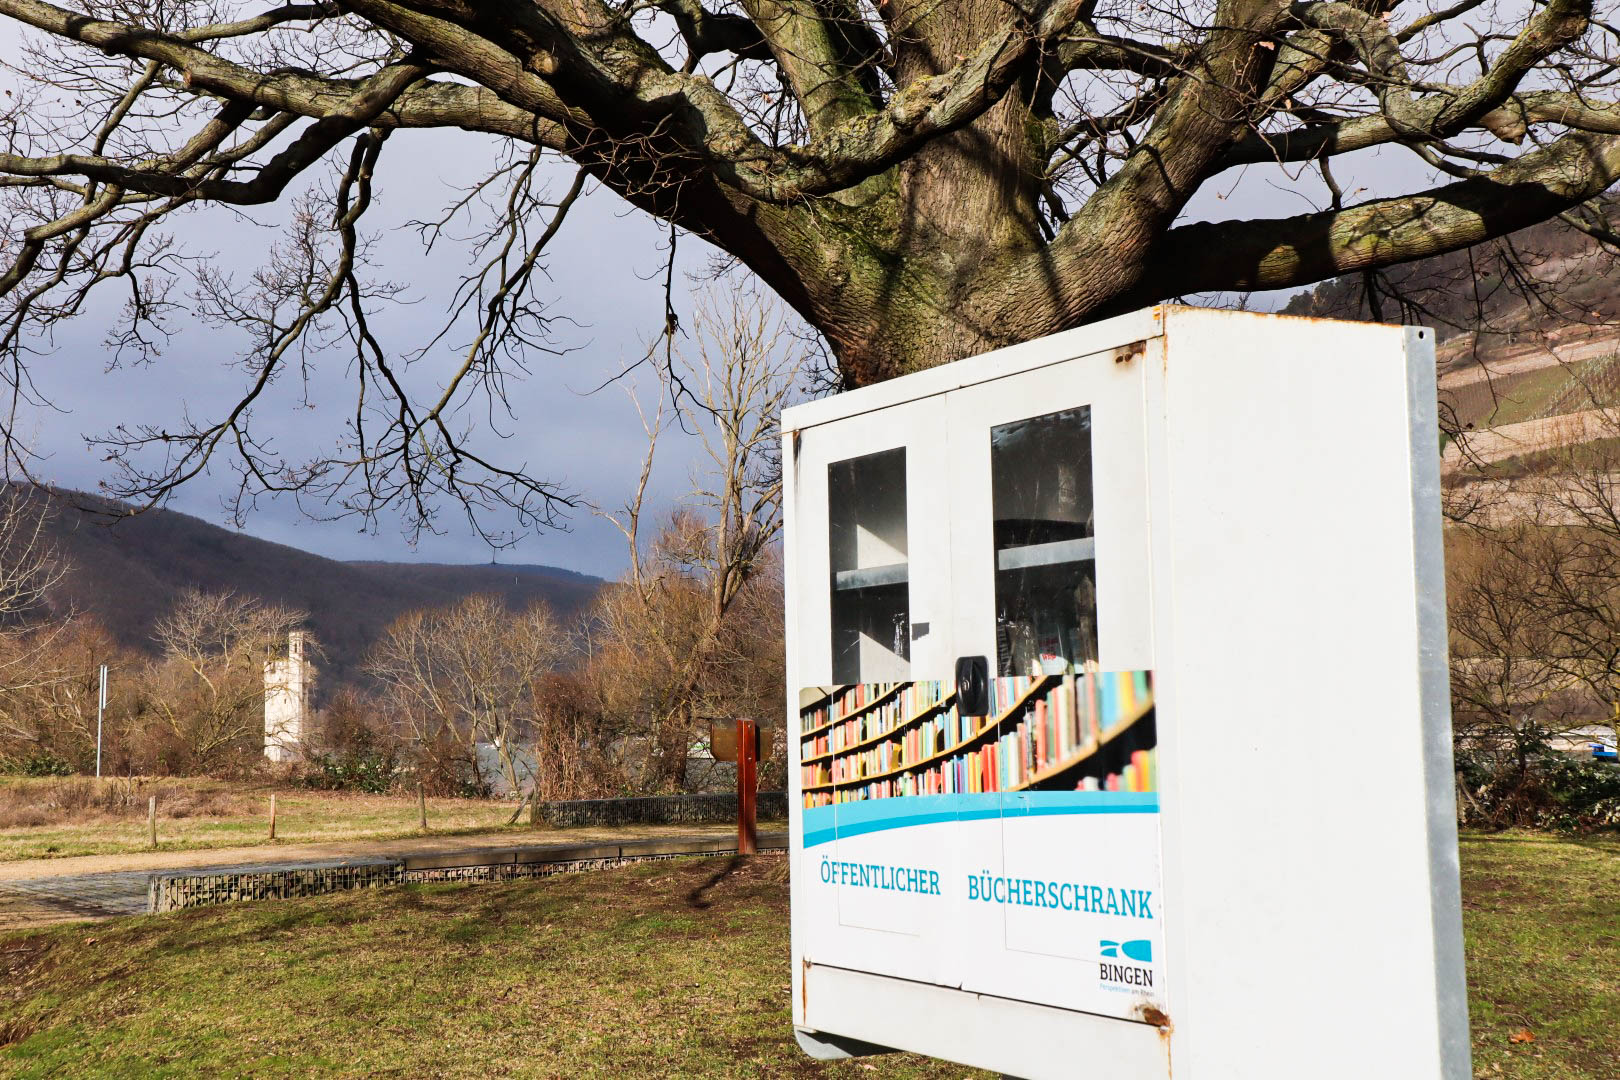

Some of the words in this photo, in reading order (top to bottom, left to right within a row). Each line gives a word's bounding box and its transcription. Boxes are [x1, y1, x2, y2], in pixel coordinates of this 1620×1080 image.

[820, 855, 941, 896] ÖFFENTLICHER
[967, 869, 1154, 919] BÜCHERSCHRANK
[1099, 963, 1153, 987] BINGEN
